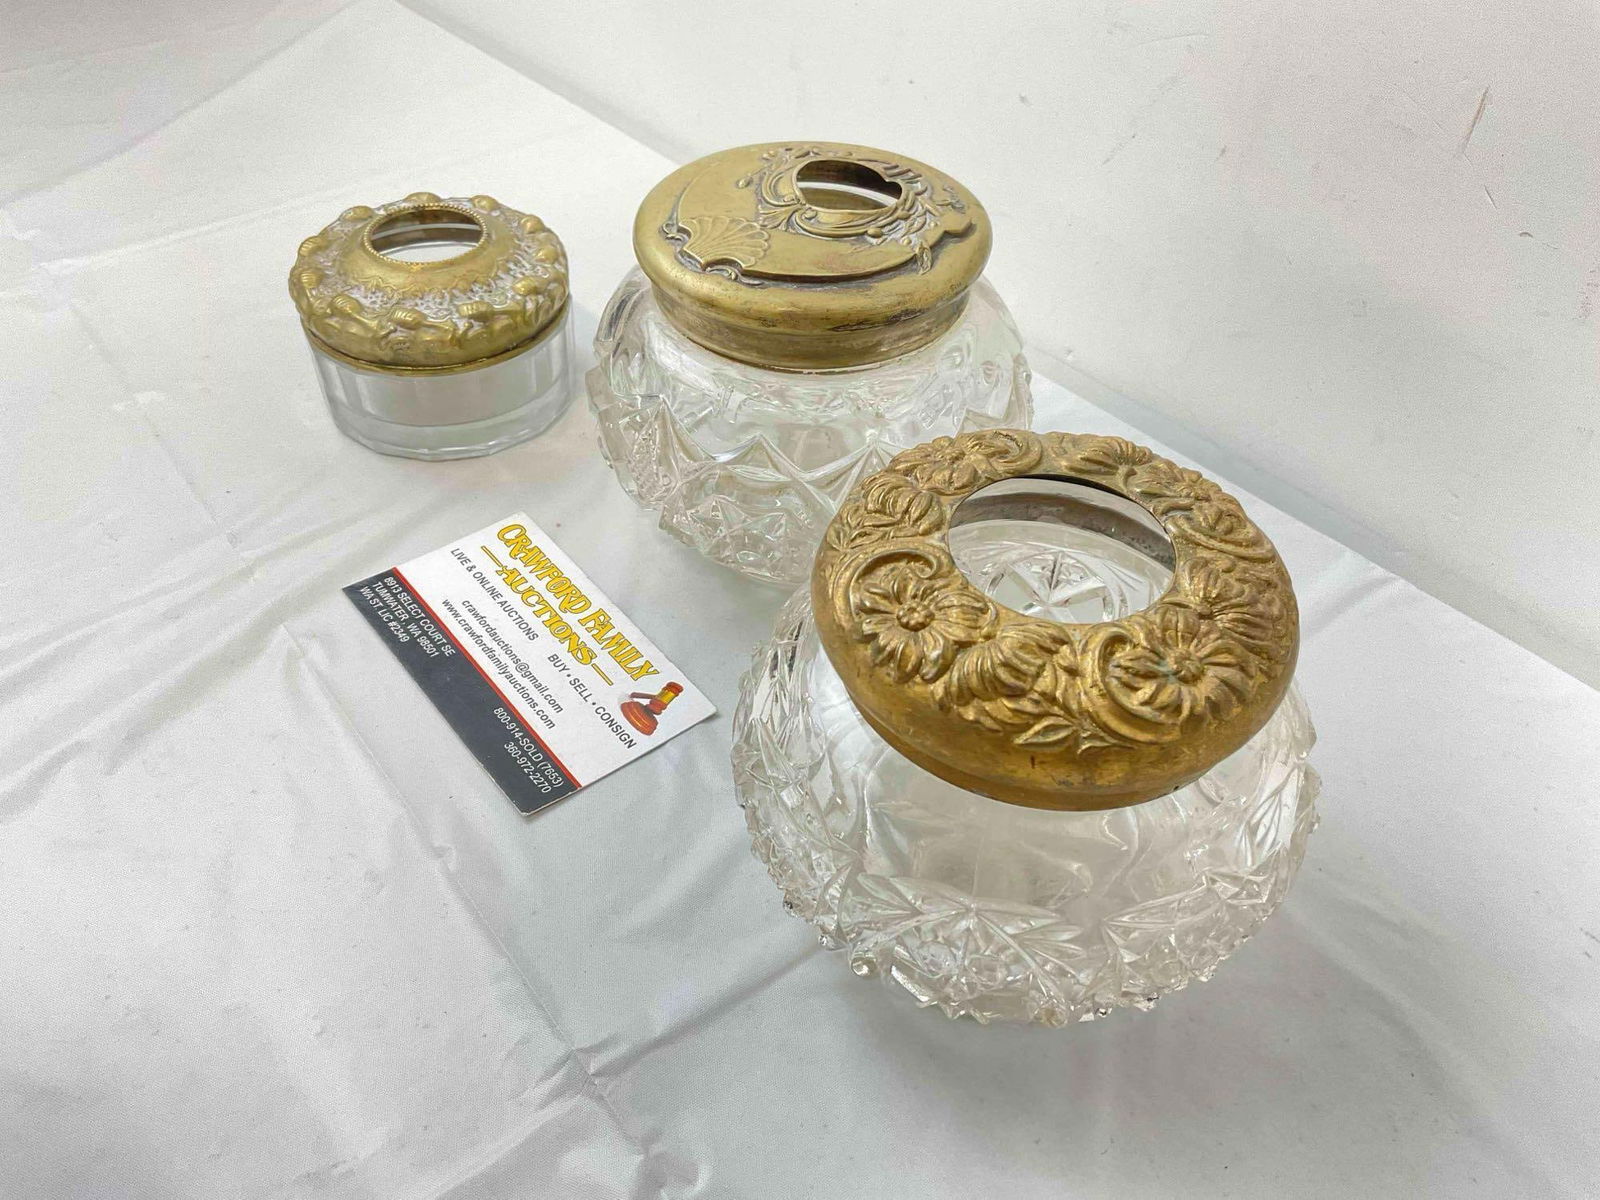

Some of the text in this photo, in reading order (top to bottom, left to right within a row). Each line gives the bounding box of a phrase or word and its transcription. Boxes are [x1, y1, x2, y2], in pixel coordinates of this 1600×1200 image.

[359, 585, 374, 599] WA
[377, 608, 393, 621] LIC
[387, 620, 409, 642] #2349
[396, 591, 425, 618] SELECT
[419, 618, 447, 644] COURT
[440, 644, 455, 656] SE
[406, 622, 421, 637] WA
[416, 635, 439, 657] 98501
[450, 548, 471, 565] LIVE
[472, 571, 503, 600] ONLINE
[496, 600, 538, 640] AUCTIONS
[495, 565, 597, 664] AUCTIONS
[497, 523, 658, 680] CRAWFORD FAMILY
[442, 599, 555, 729] www.crawfordfamilyauctions.com
[461, 600, 563, 713] crawfordauctions@gmail.com
[547, 653, 636, 748] BUY SELL CONSIGN
[493, 707, 563, 787] 800-914-SOLD (7653)
[503, 741, 551, 792] 360-972-2270
